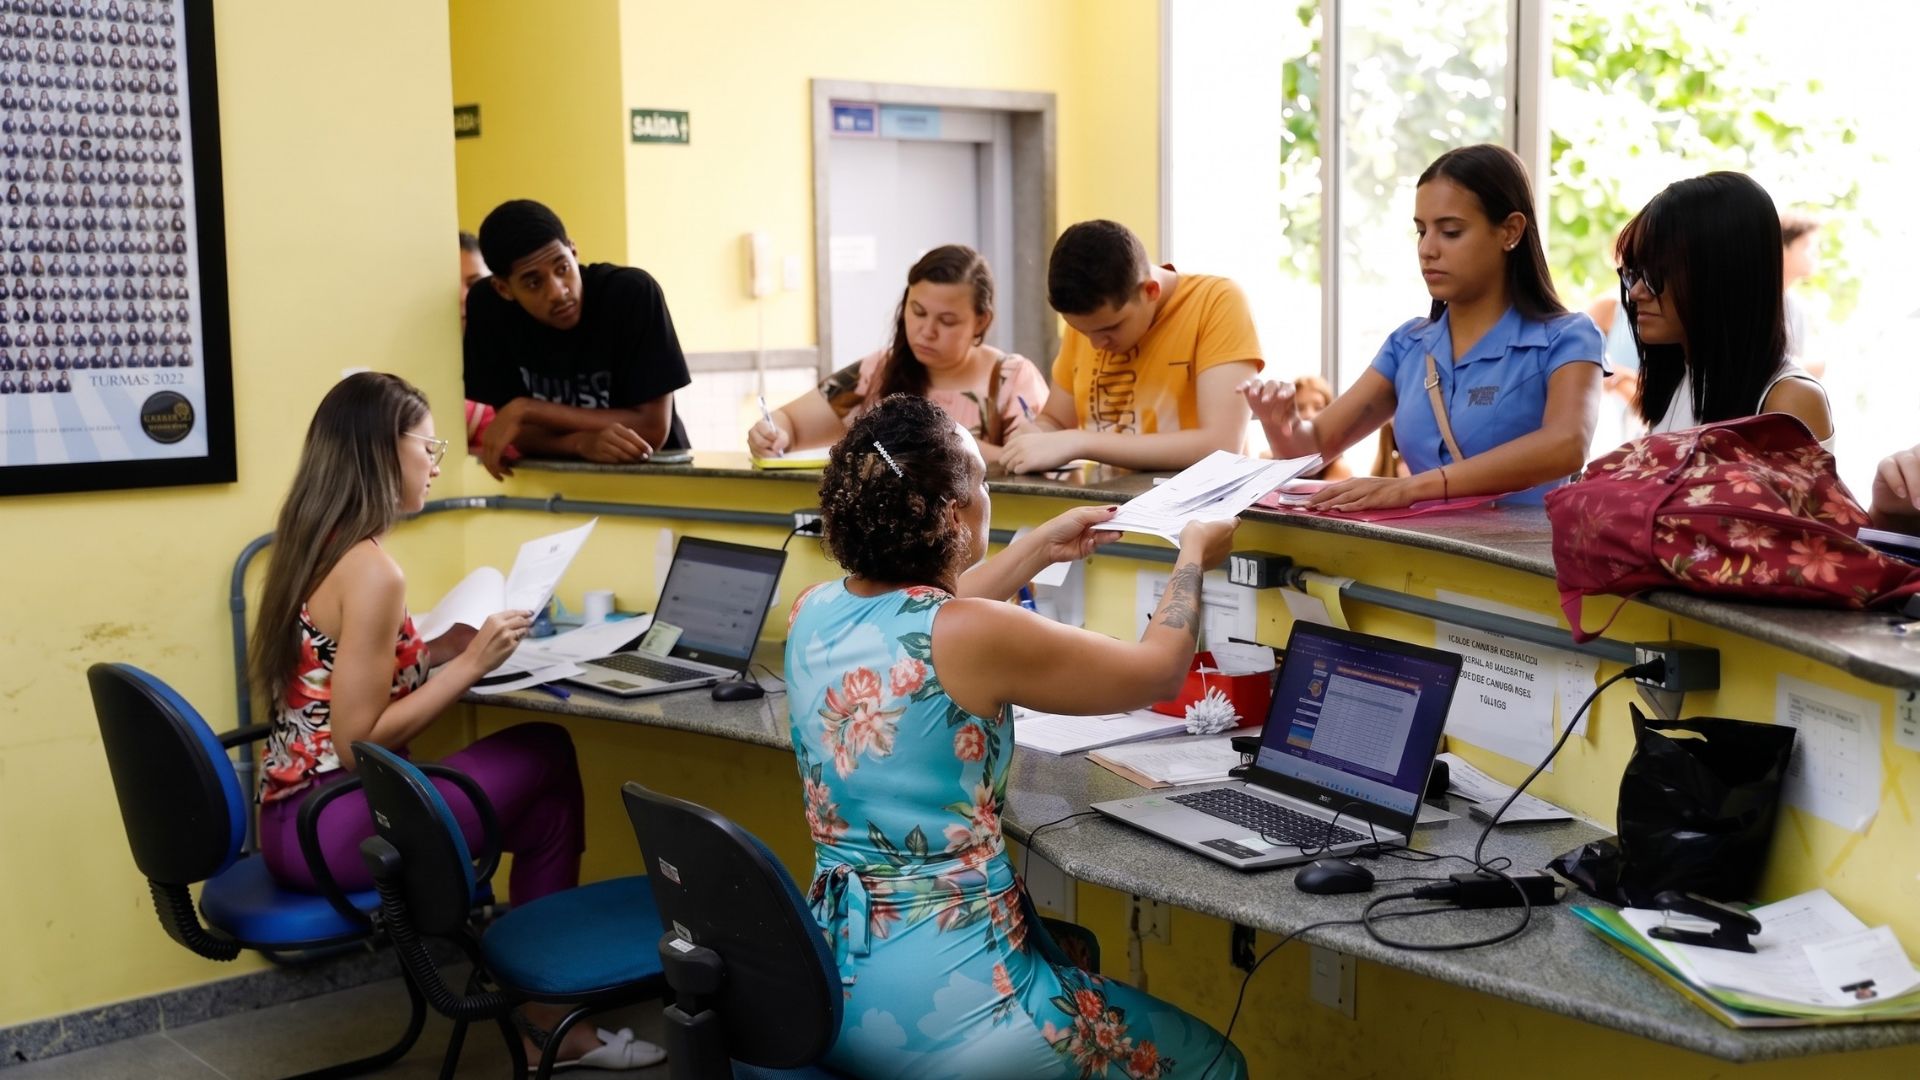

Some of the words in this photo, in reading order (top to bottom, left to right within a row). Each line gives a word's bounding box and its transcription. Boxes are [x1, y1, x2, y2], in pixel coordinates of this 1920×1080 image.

[633, 112, 680, 138] SAÍDA
[89, 375, 150, 387] TURMAS
[154, 373, 185, 385] 2022
